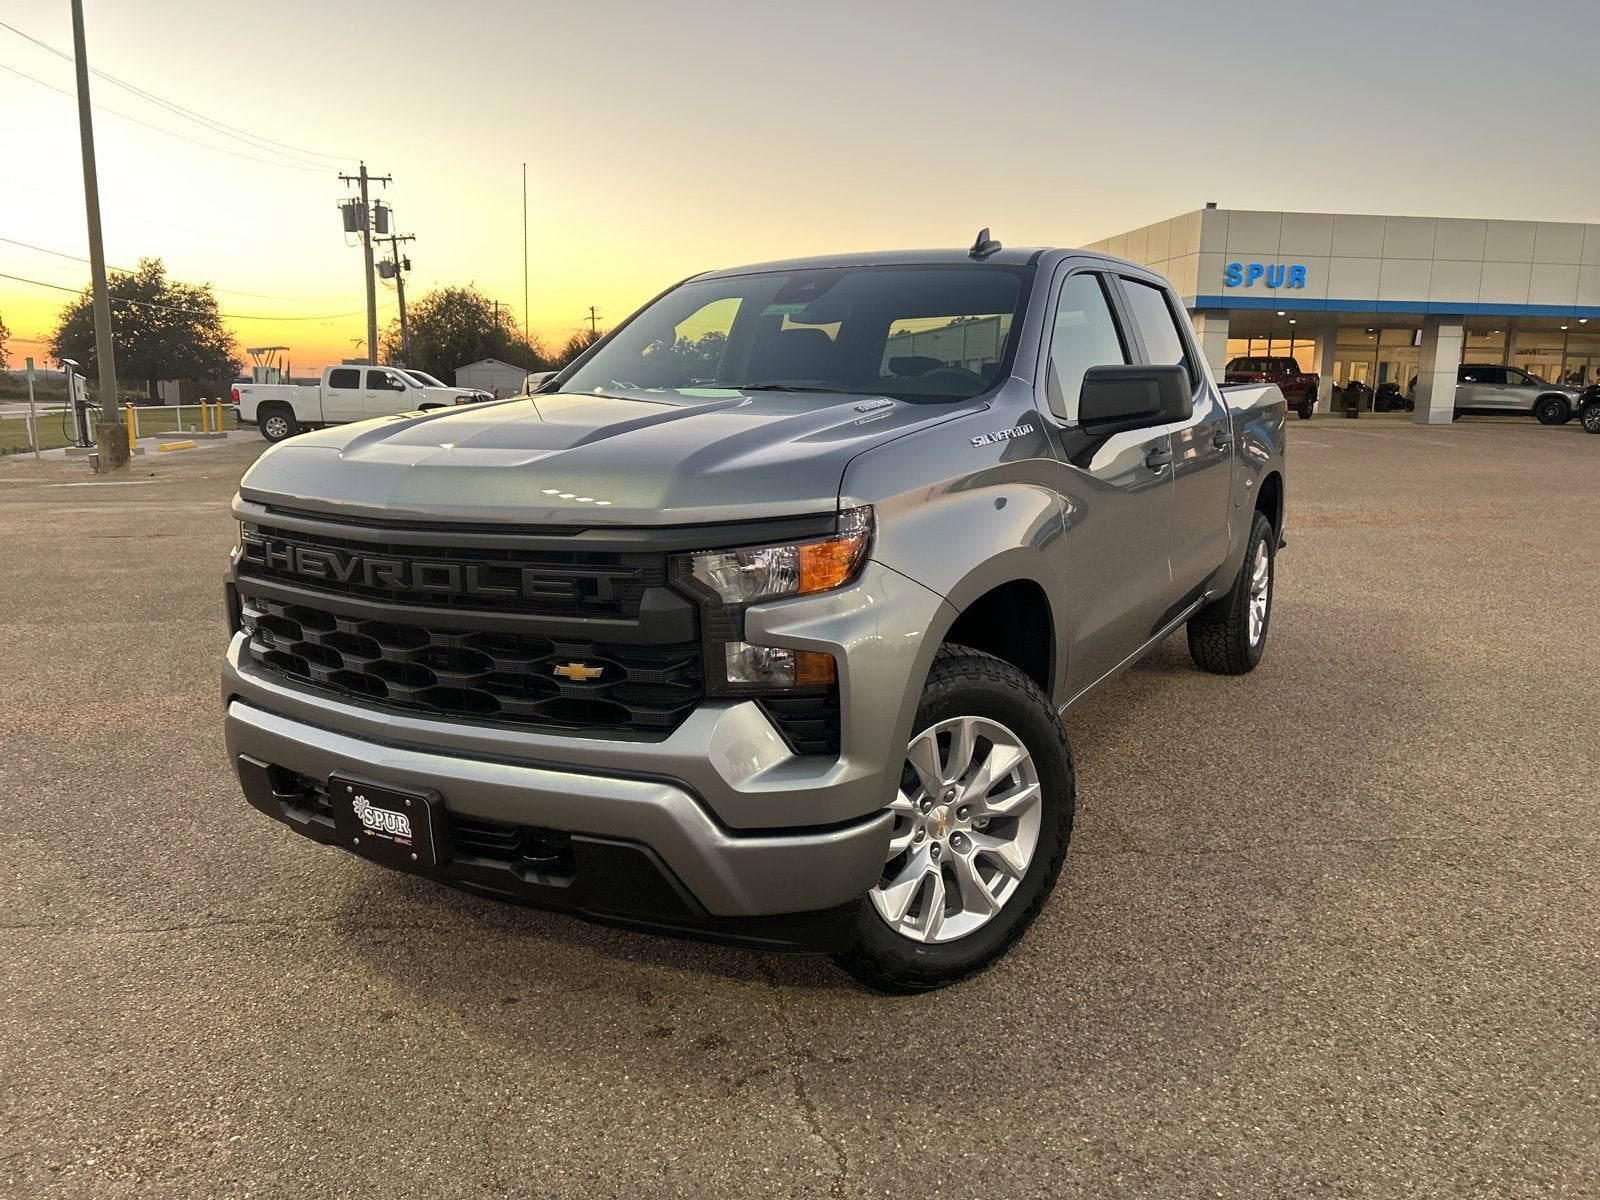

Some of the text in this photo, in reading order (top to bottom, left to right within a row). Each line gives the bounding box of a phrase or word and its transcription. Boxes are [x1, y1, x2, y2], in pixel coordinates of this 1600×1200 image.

[1225, 262, 1307, 288] SPUR
[969, 423, 1034, 448] SILVERADO
[242, 536, 642, 601] CHEVROLET
[363, 807, 411, 836] SPUR
